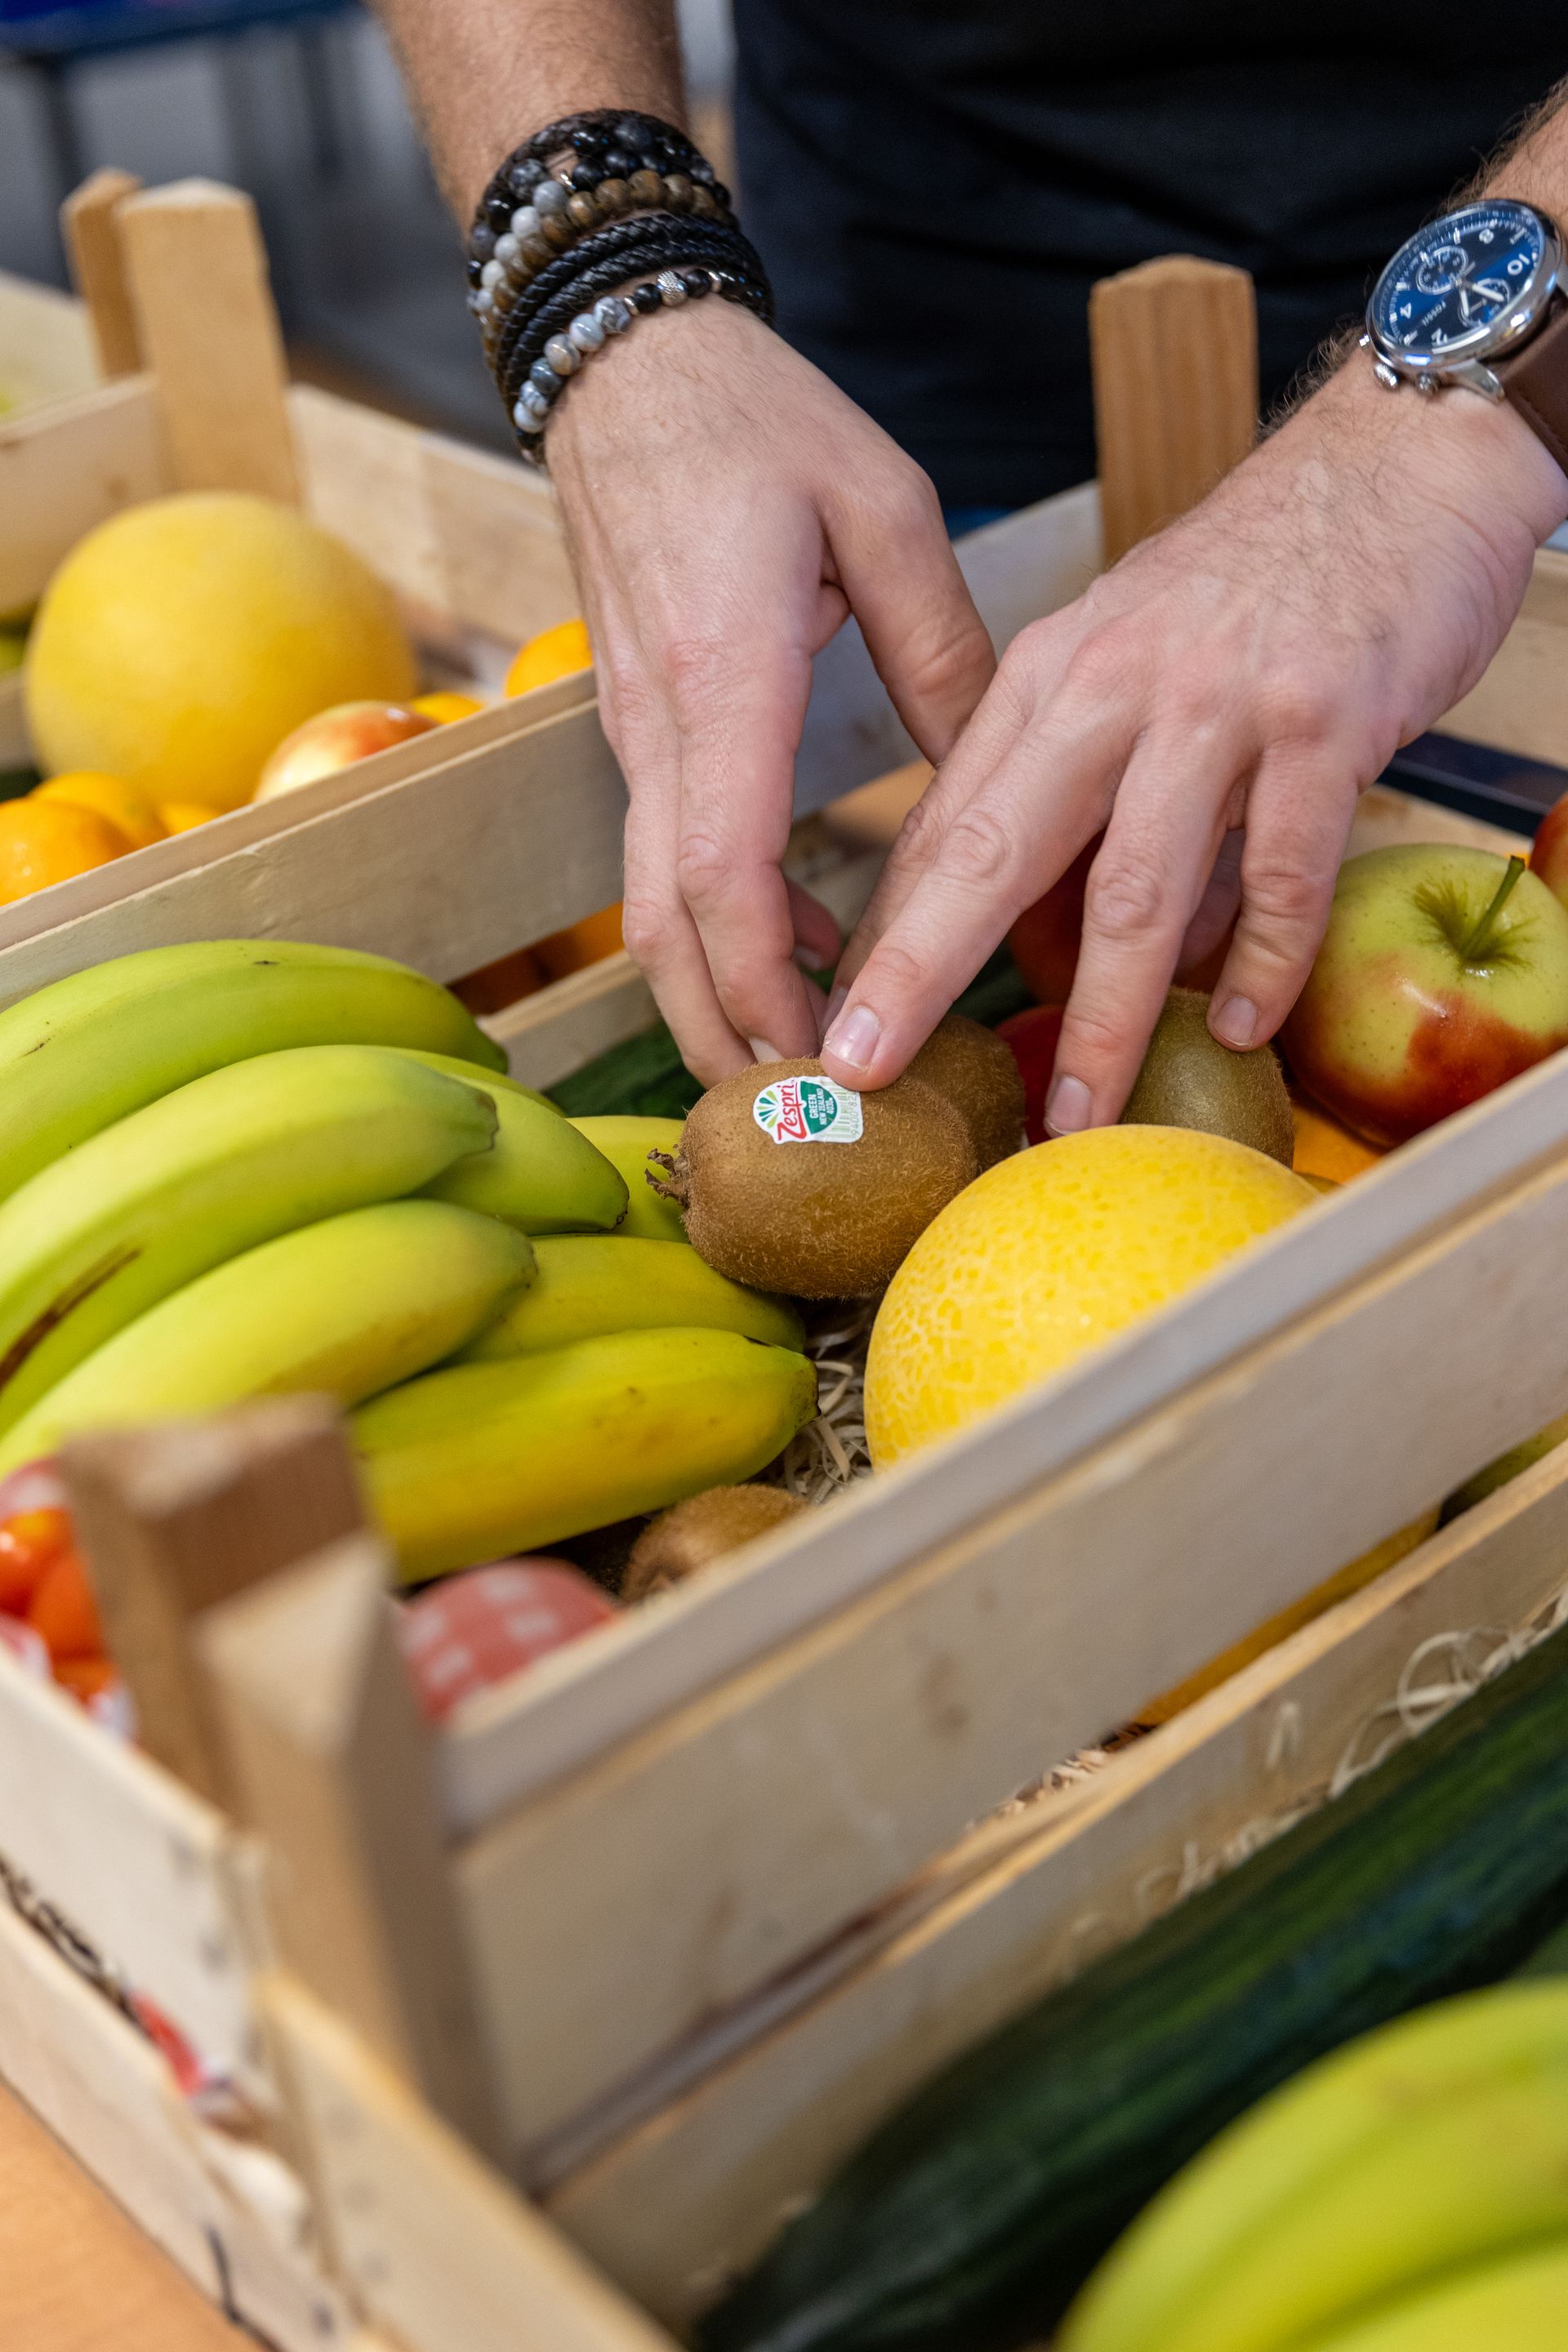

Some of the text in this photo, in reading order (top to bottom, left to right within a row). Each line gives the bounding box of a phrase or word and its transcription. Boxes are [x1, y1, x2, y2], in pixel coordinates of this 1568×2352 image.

[1507, 253, 1530, 275] 10
[1400, 302, 1412, 318] 4
[777, 1084, 807, 1141] Zespri
[808, 1094, 818, 1118] GREEN
[817, 1088, 827, 1125] NEW ZEALAND
